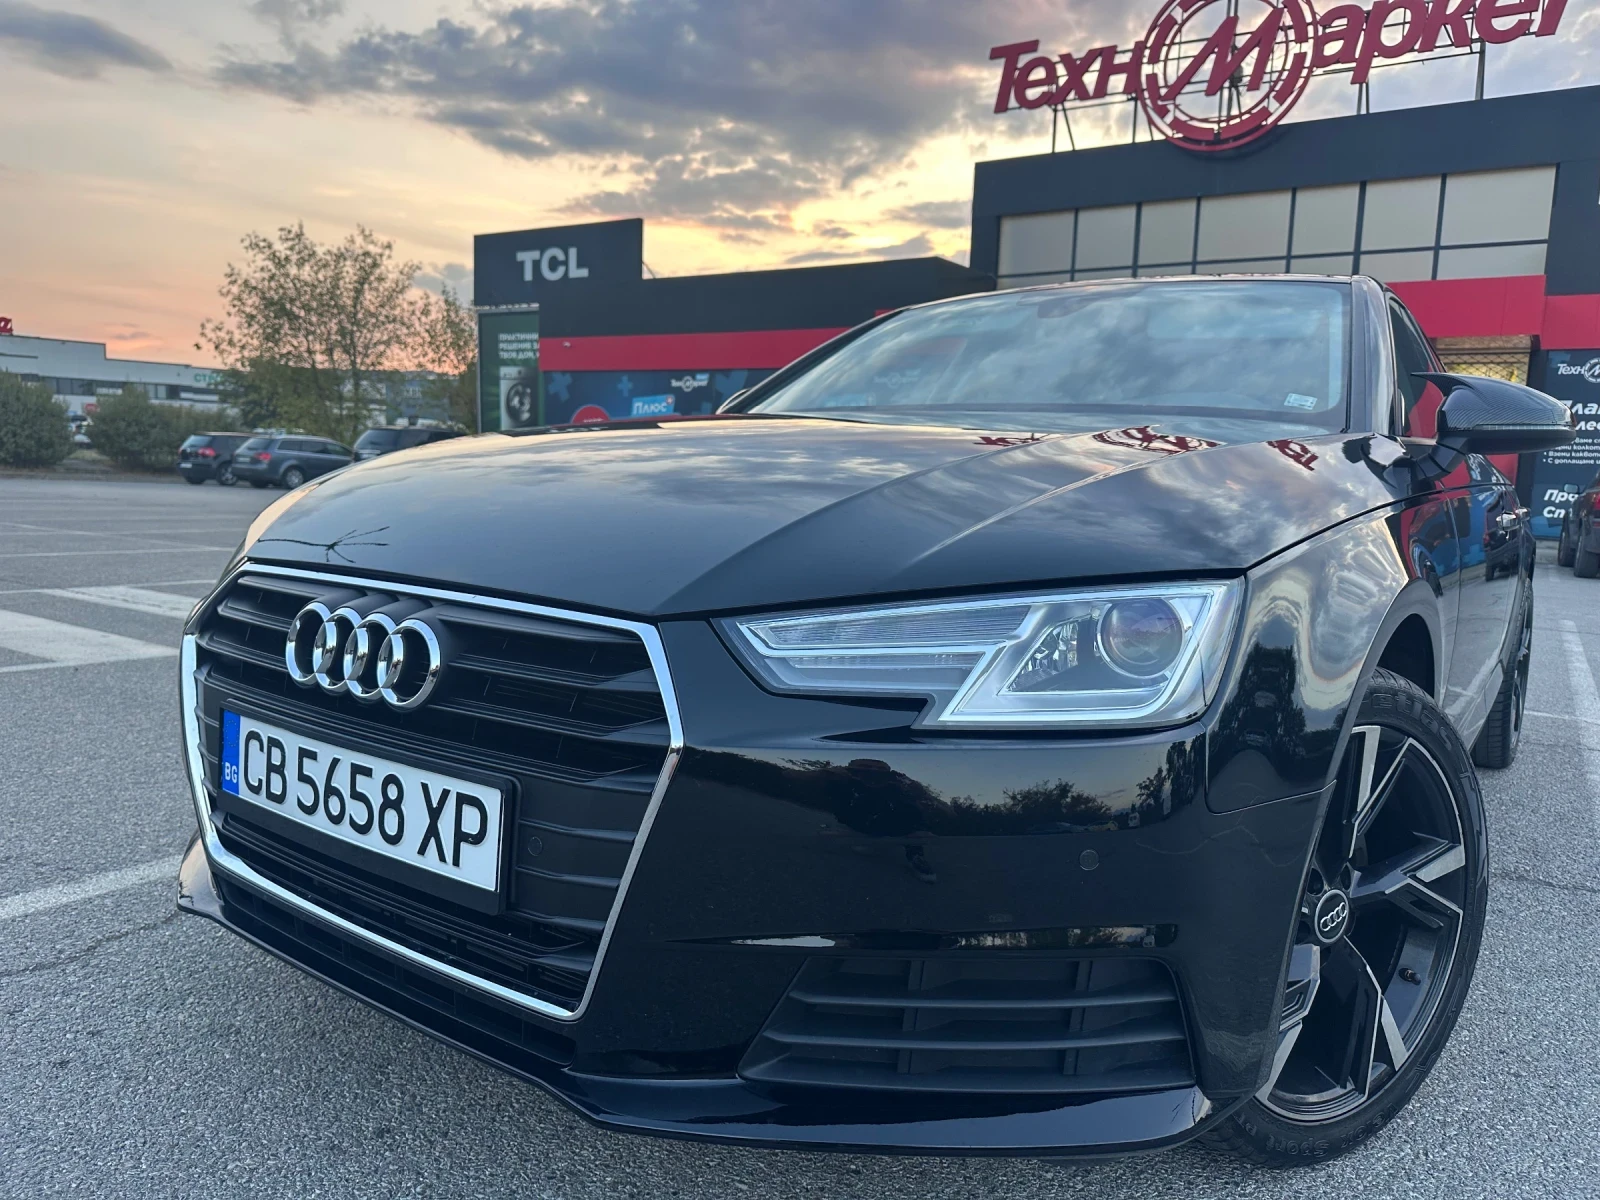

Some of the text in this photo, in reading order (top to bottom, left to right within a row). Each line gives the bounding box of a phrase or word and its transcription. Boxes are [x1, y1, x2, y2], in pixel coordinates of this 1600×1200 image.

[516, 247, 589, 282] TCL
[223, 761, 239, 784] BG
[297, 745, 405, 847] 5658
